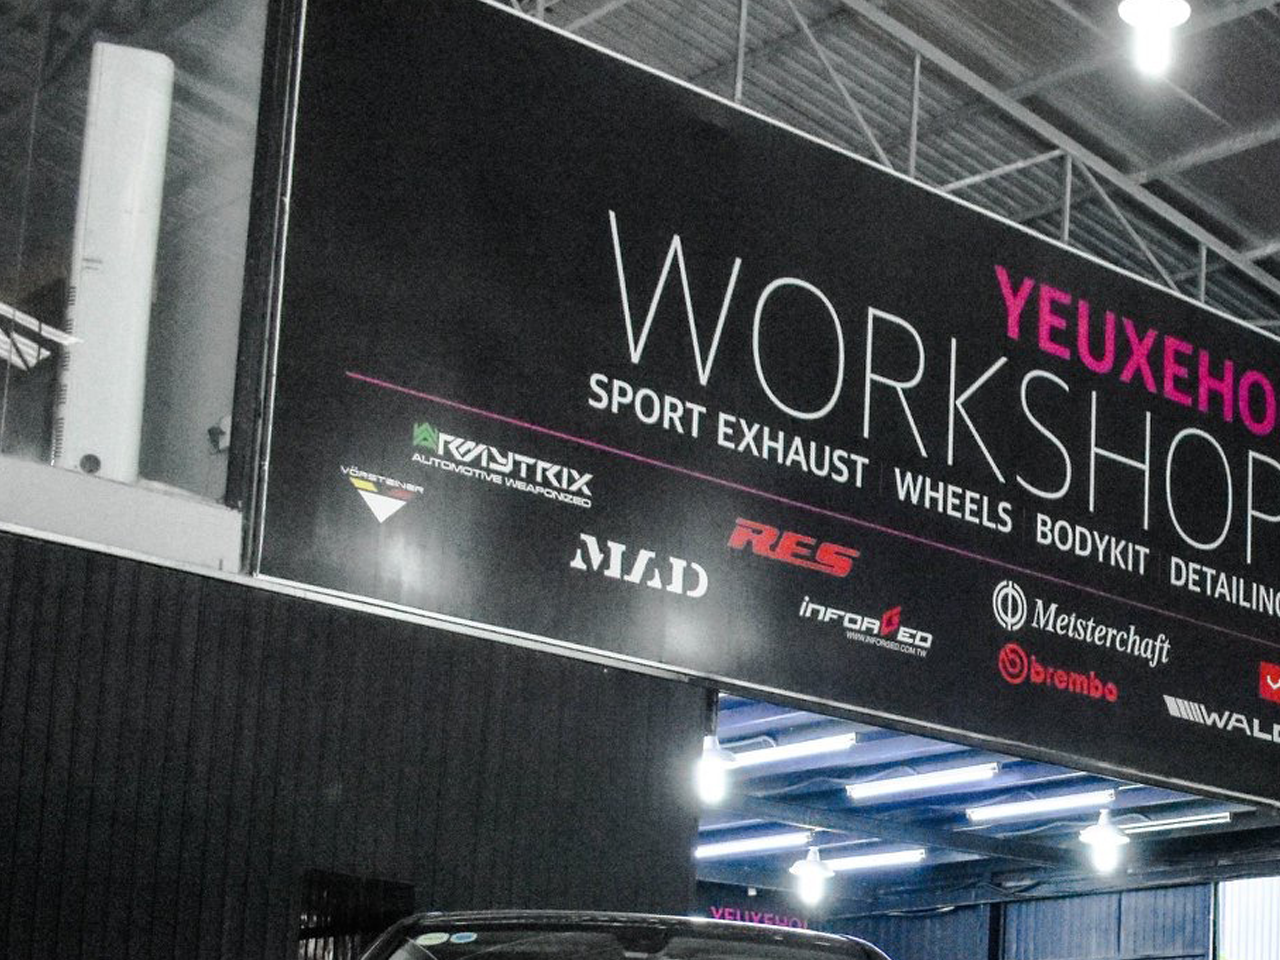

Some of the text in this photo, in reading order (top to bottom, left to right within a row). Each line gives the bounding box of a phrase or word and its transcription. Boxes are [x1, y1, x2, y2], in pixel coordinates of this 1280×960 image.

[412, 452, 592, 508] AUTOMOTIVE WEAPONIZED
[588, 373, 706, 438] SPORT
[717, 411, 869, 488] EXHAUST
[894, 467, 1013, 533] WHEELS
[1036, 513, 1150, 576] BODYKIT
[570, 533, 709, 598] MAD
[727, 517, 861, 578] RES
[1032, 598, 1171, 668] Meisterchaft
[1029, 654, 1119, 702] brembo
